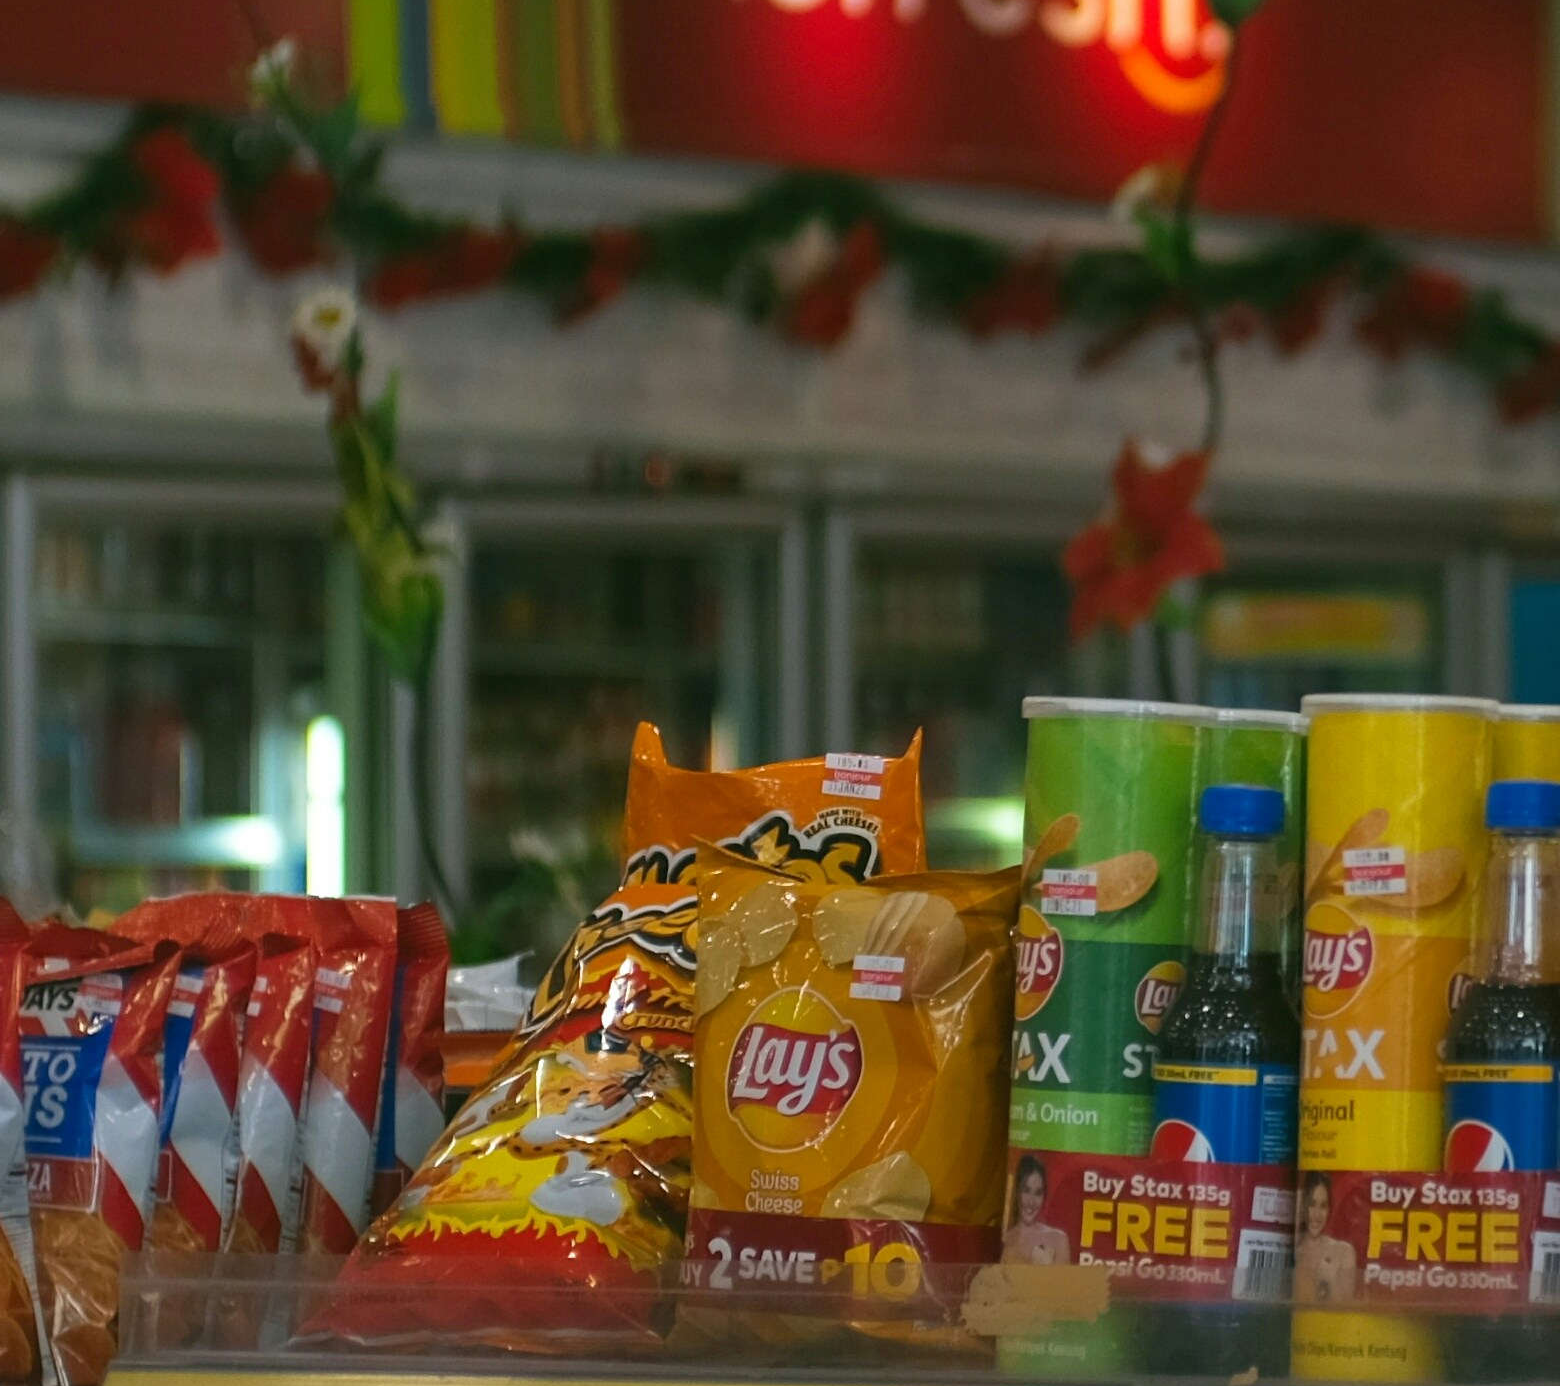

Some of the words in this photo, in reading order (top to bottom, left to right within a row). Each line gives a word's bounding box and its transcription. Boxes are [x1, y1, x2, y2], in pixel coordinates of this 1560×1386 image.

[803, 818, 831, 839] REAL
[833, 816, 879, 834] CHEESE!
[731, 1027, 855, 1115] Lay's
[1040, 1103, 1097, 1126] Onion
[751, 1170, 800, 1191] Swiss
[1083, 1171, 1124, 1196] Buy
[1130, 1174, 1182, 1199] Stax
[1188, 1182, 1231, 1206] 135g
[1370, 1181, 1416, 1208] Buy
[1421, 1182, 1472, 1206] Stax
[1477, 1187, 1520, 1209] 135g
[745, 1193, 802, 1213] Cheese
[1080, 1199, 1230, 1258] FREE
[1366, 1210, 1520, 1263] FREE
[708, 1237, 733, 1290] 2
[739, 1248, 816, 1284] SAVE
[1137, 1258, 1165, 1281] Go
[1167, 1264, 1226, 1285] 330mL
[1364, 1262, 1423, 1292] Pepsi
[1427, 1266, 1457, 1290] Go
[1459, 1269, 1519, 1291] 330mL
